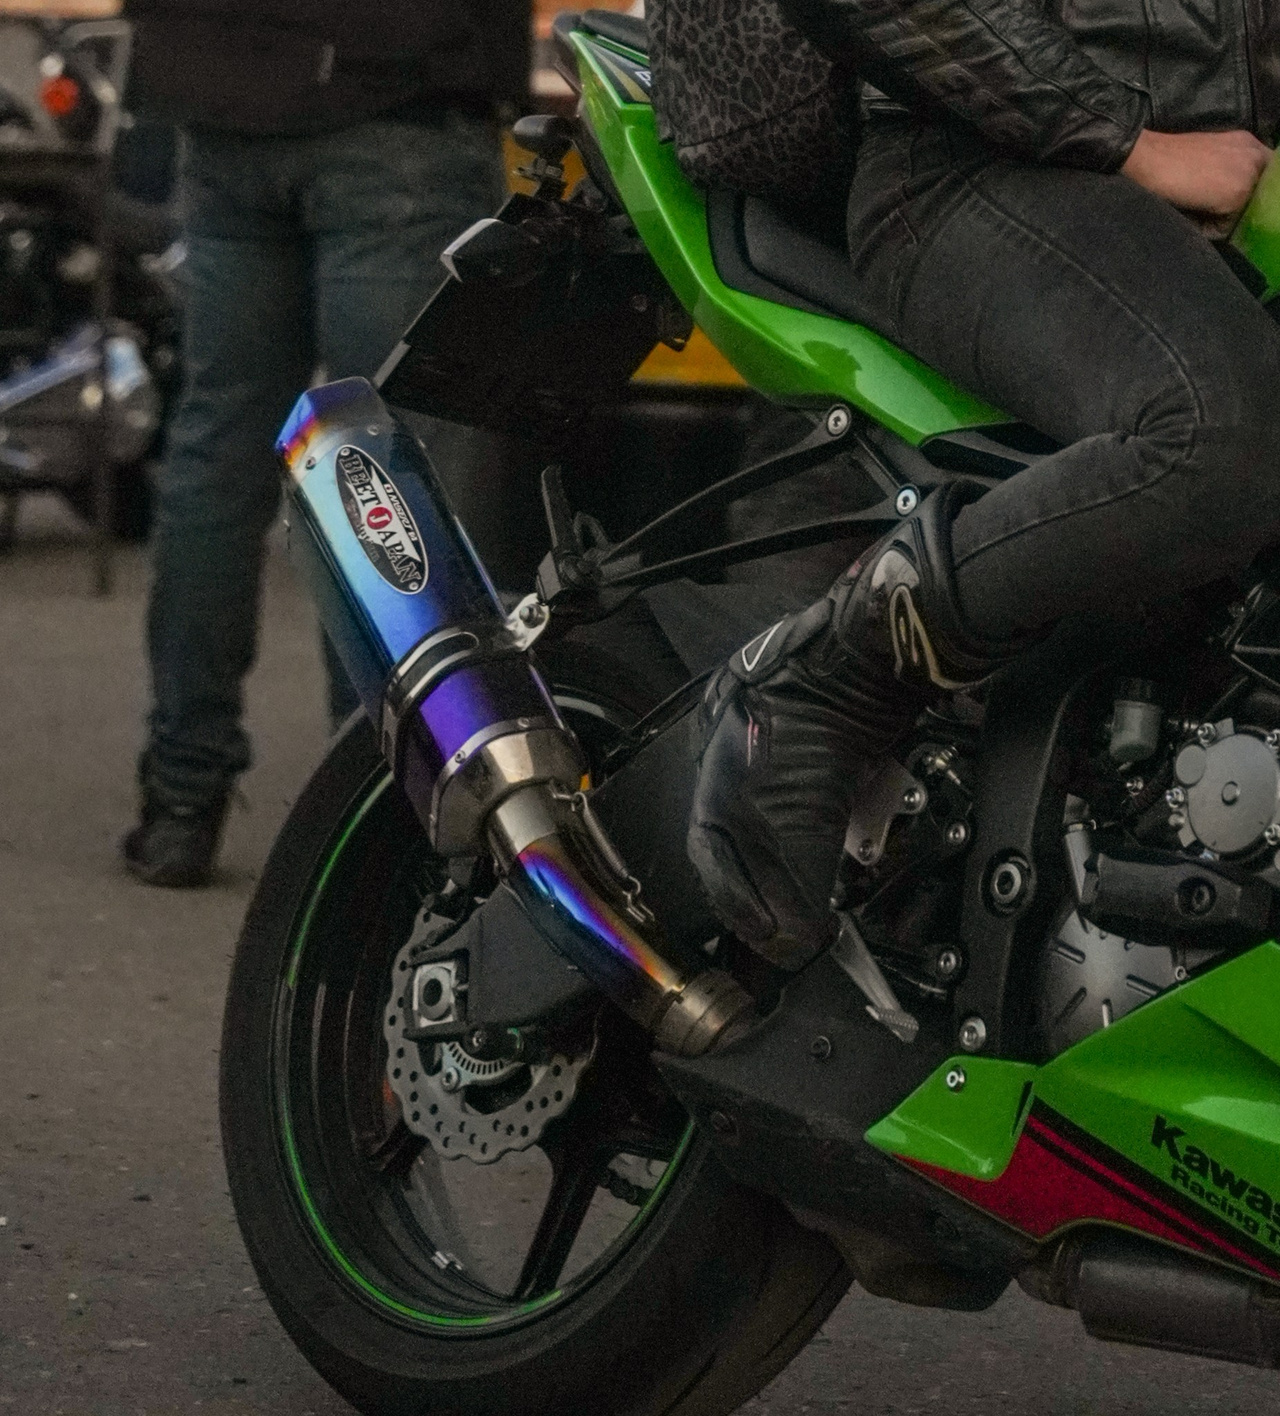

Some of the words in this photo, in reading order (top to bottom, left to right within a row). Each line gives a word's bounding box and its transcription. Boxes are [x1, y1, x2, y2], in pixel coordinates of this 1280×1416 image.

[339, 454, 382, 507] BEET
[367, 507, 422, 583] JAPAN
[1171, 1165, 1260, 1235] Racing
